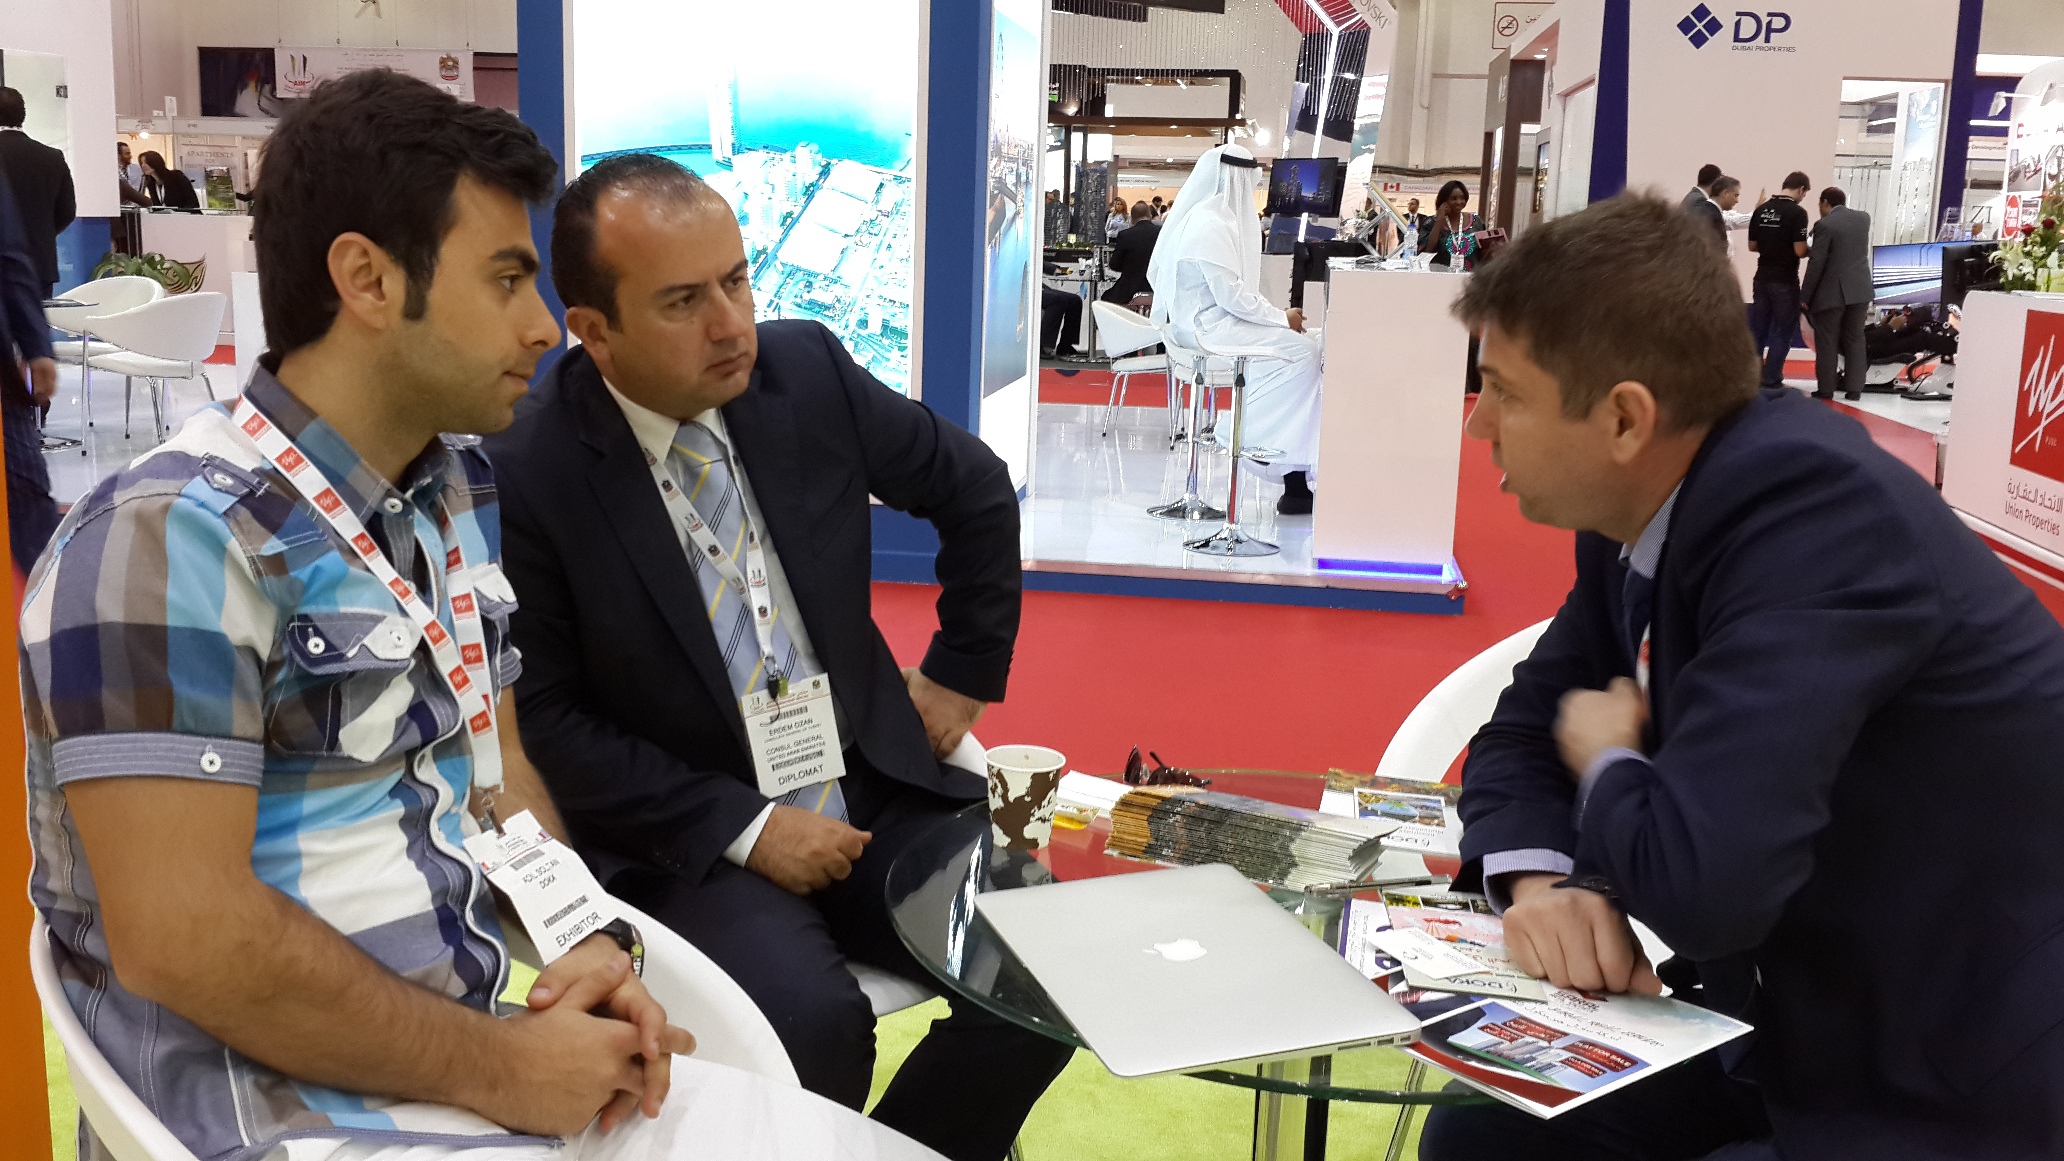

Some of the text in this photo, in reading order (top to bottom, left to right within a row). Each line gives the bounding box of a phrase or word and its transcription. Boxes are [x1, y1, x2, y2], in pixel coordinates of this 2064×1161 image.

[1354, 0, 1388, 29] OVSKI
[1733, 11, 1792, 43] DP
[1755, 45, 1796, 53] PROPERTIES
[2005, 500, 2061, 536] Union Properties
[769, 723, 793, 736] ERDEM
[794, 734, 824, 747] GENERAL
[778, 764, 824, 786] DIPLOMAT
[555, 911, 602, 948] EXHIBITOR
[1446, 977, 1502, 990] DOKA
